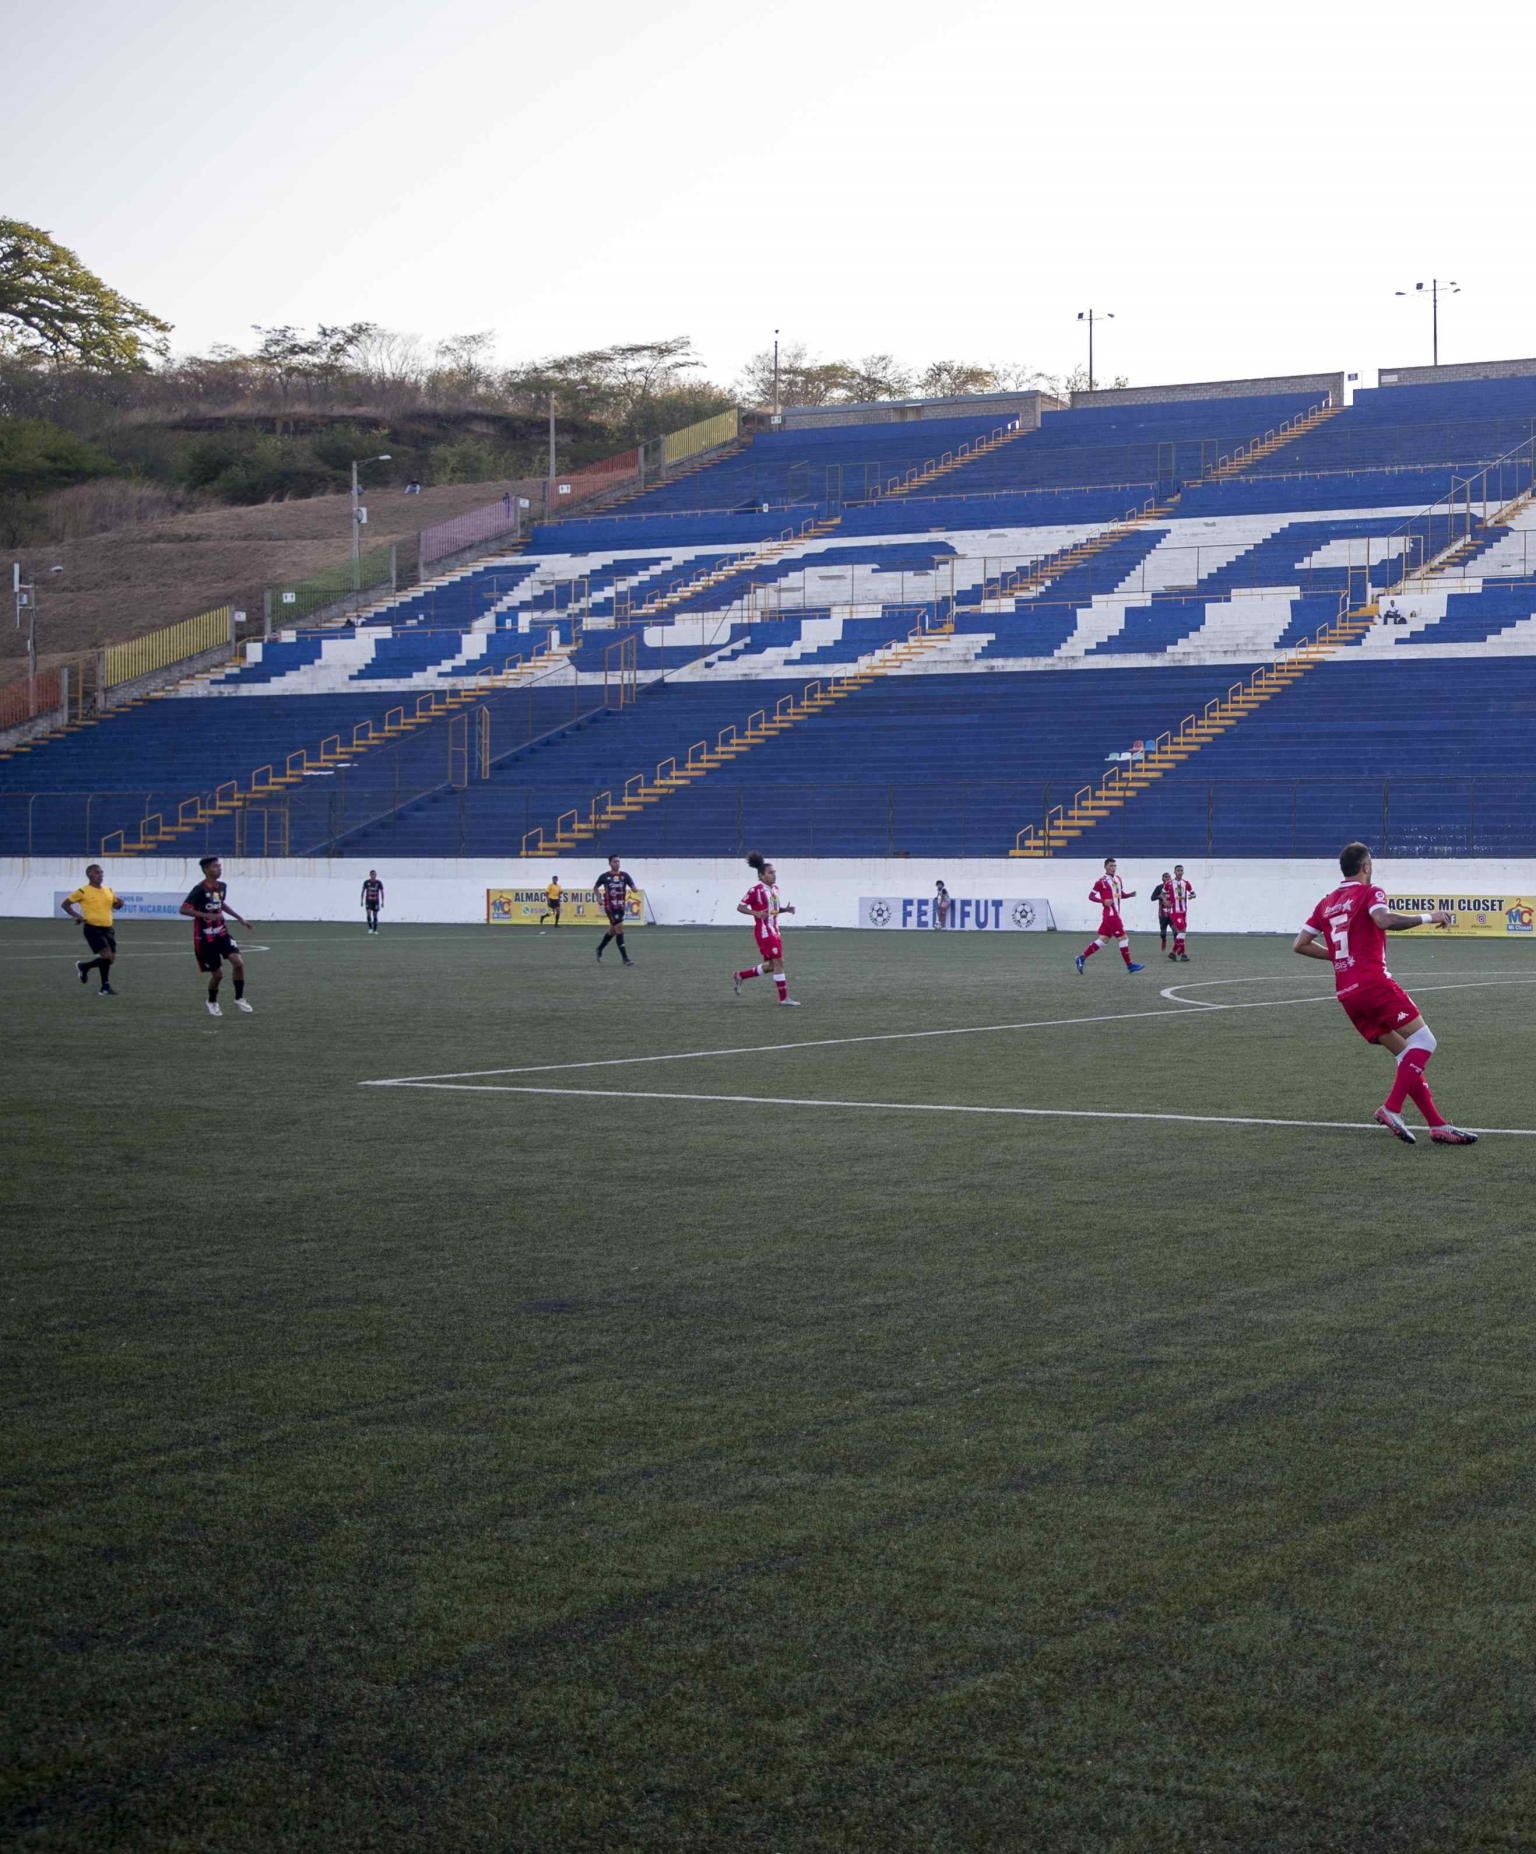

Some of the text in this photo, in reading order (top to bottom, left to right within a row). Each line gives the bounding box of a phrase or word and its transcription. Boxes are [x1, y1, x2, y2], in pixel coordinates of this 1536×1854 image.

[514, 892, 569, 903] ALMACES
[1388, 898, 1504, 911] ACENES MI CLOSET
[1508, 908, 1532, 926] MC
[1329, 913, 1349, 960] 5
